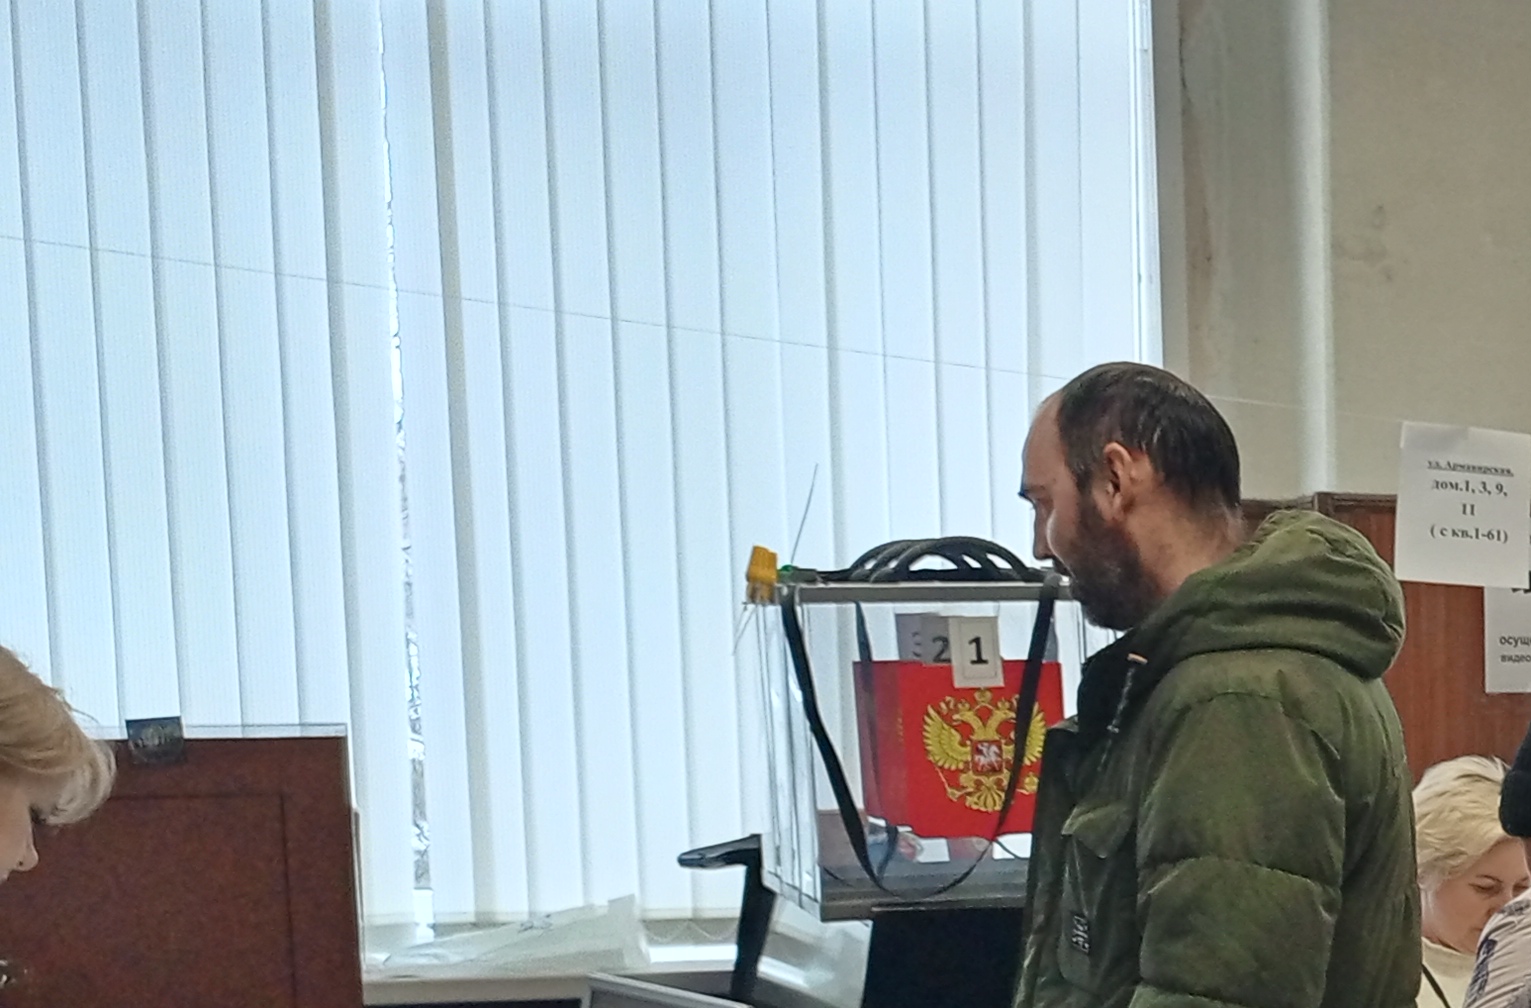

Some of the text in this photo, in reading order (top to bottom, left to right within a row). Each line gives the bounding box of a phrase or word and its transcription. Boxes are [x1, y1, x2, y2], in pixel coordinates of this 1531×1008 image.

[1495, 483, 1507, 497] 9,
[1462, 503, 1475, 516] 11
[932, 635, 951, 663] 2
[968, 636, 989, 665] 1
